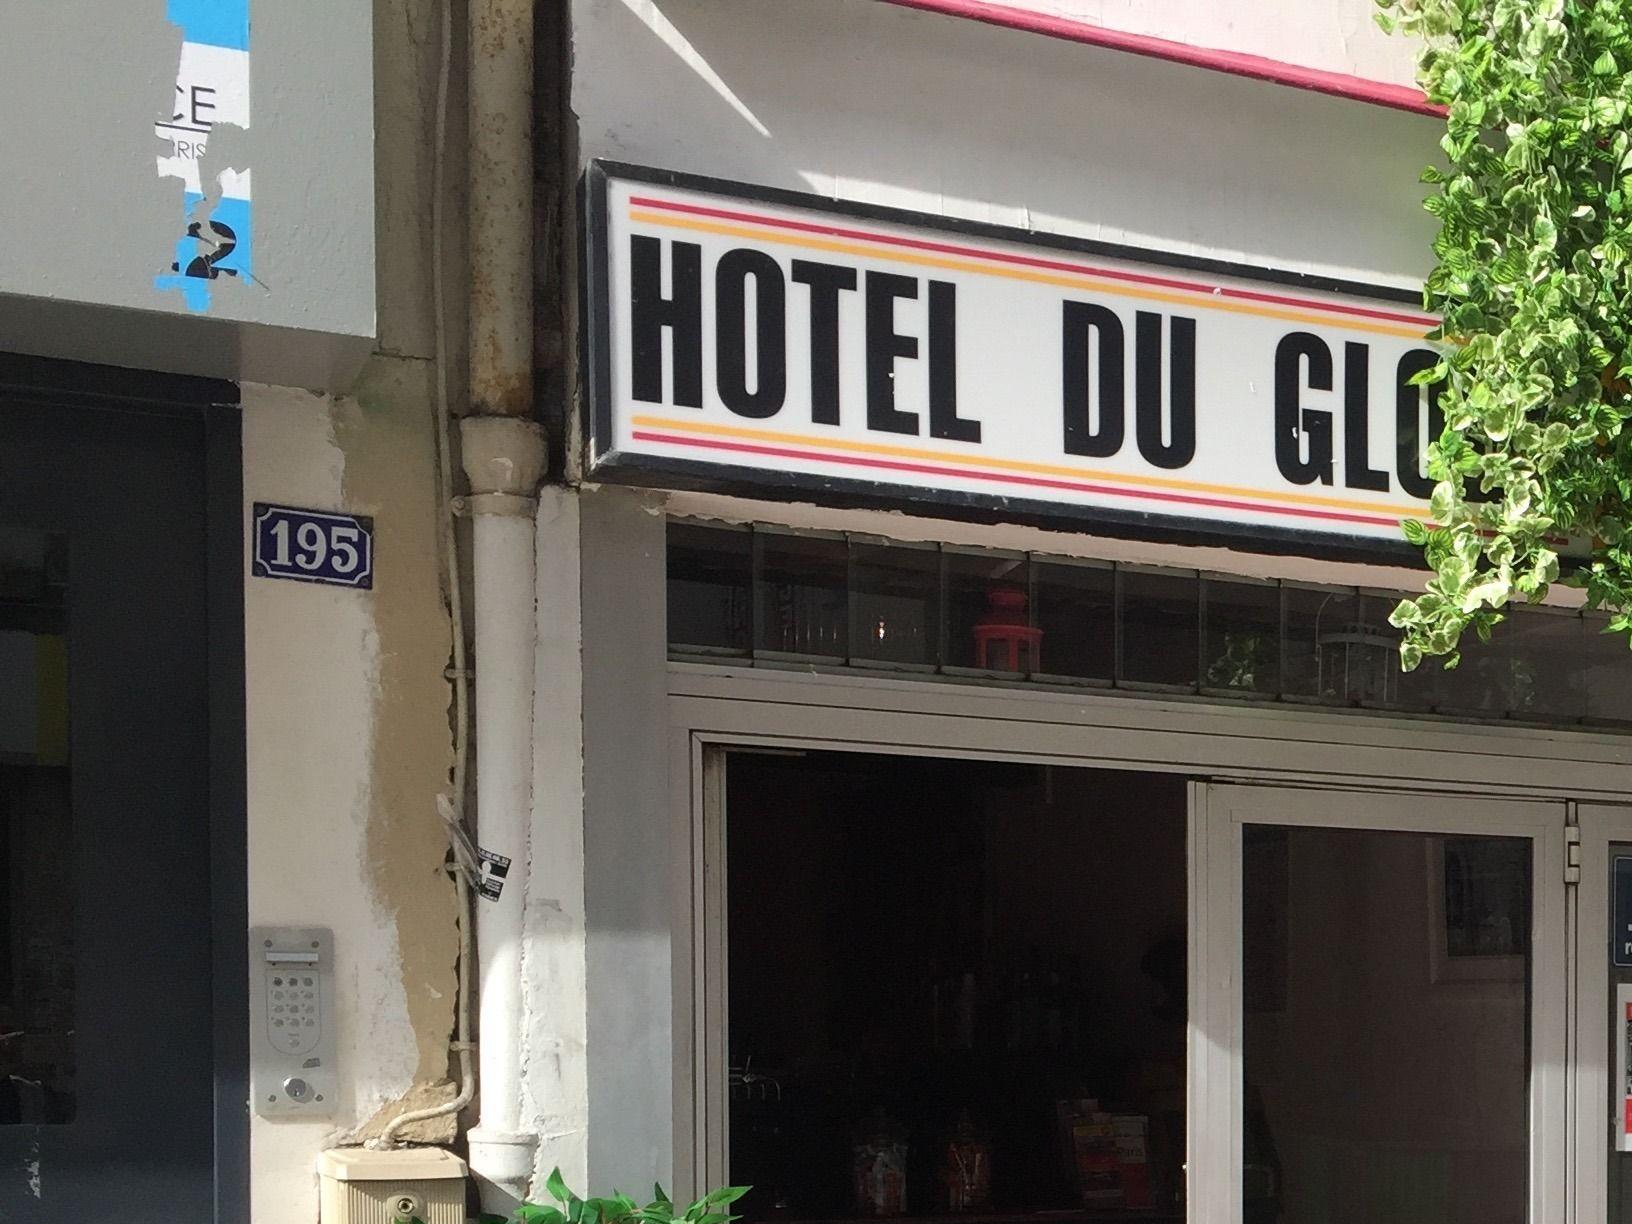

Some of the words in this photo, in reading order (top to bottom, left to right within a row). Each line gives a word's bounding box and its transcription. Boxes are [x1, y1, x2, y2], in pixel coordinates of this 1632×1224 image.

[630, 234, 981, 445] HOTEL
[1062, 299, 1197, 470] DU
[269, 522, 359, 571] 195
